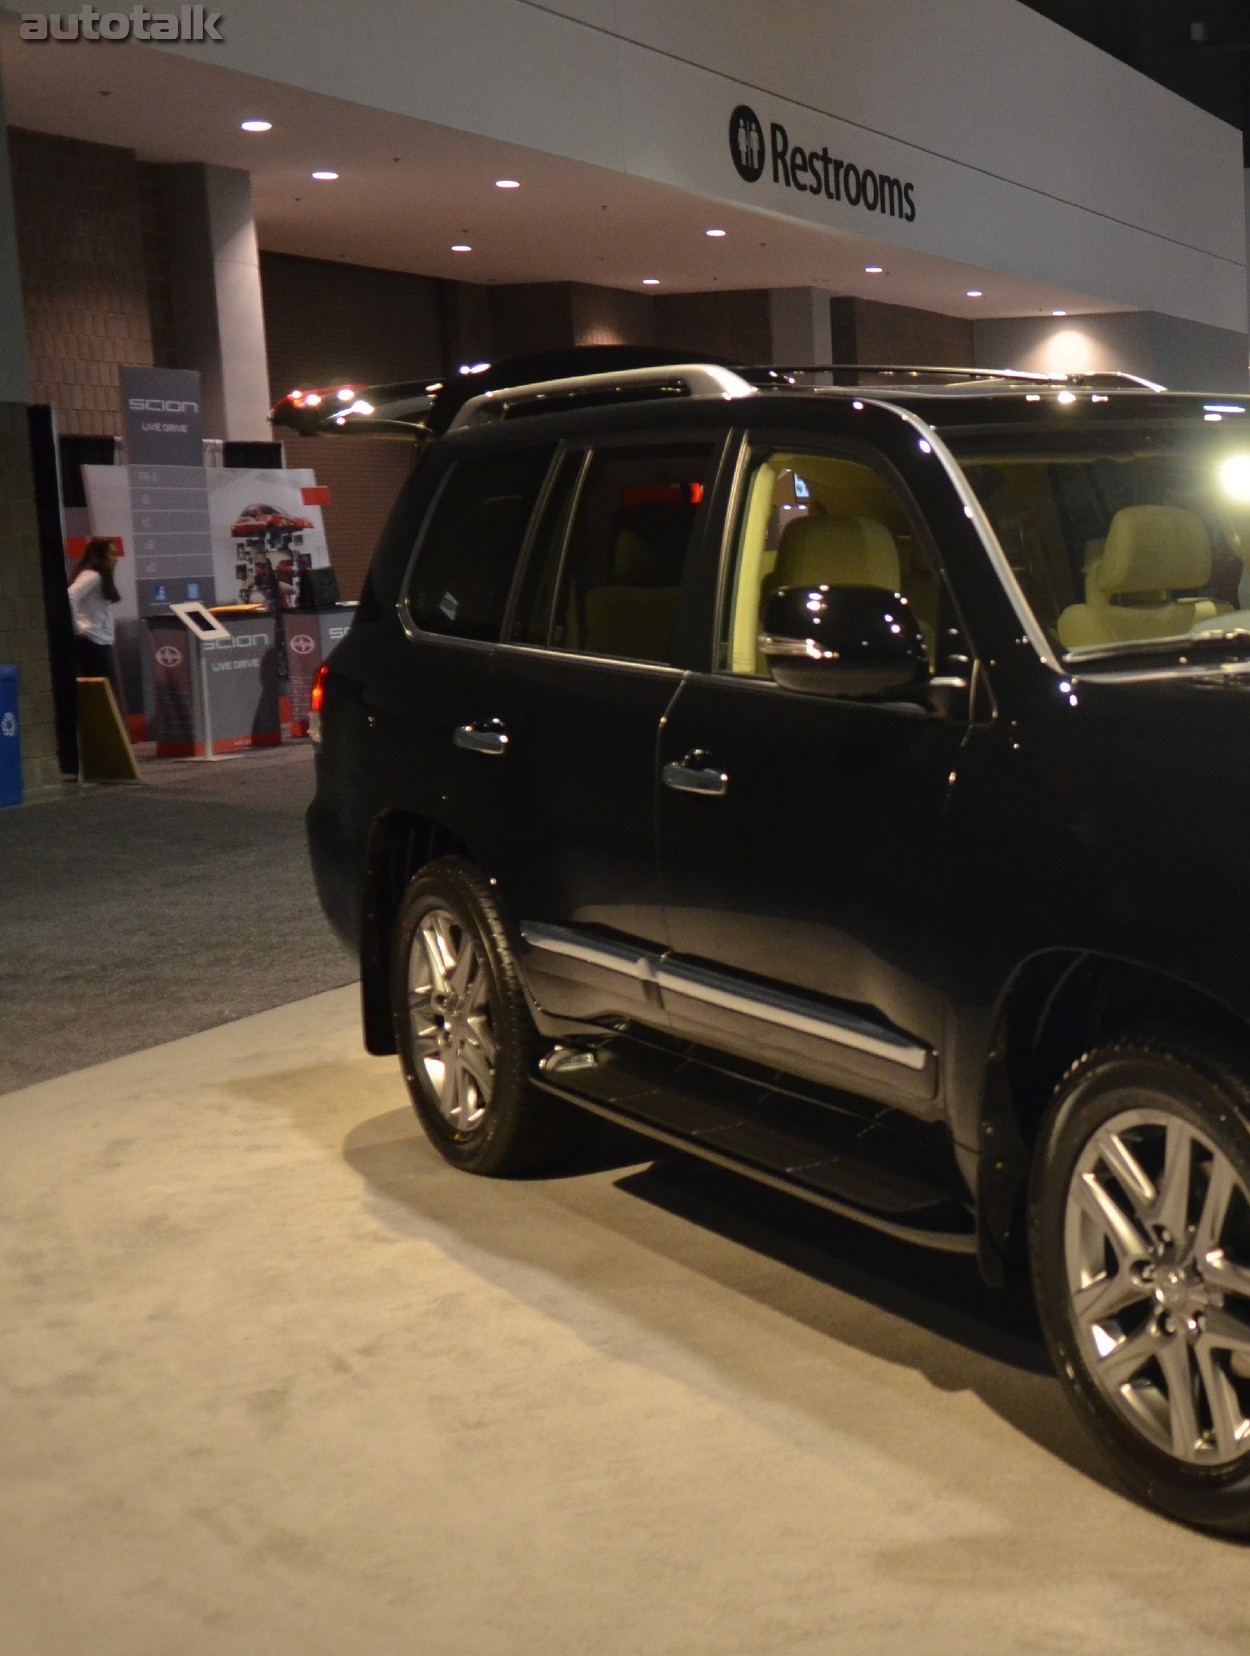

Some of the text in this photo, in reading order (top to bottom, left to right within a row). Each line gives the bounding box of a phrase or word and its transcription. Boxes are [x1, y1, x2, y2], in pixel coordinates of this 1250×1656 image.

[770, 122, 916, 222] Restrooms
[141, 422, 188, 432] LIVE DRIVE
[212, 658, 260, 671] LIVE DRIVE
